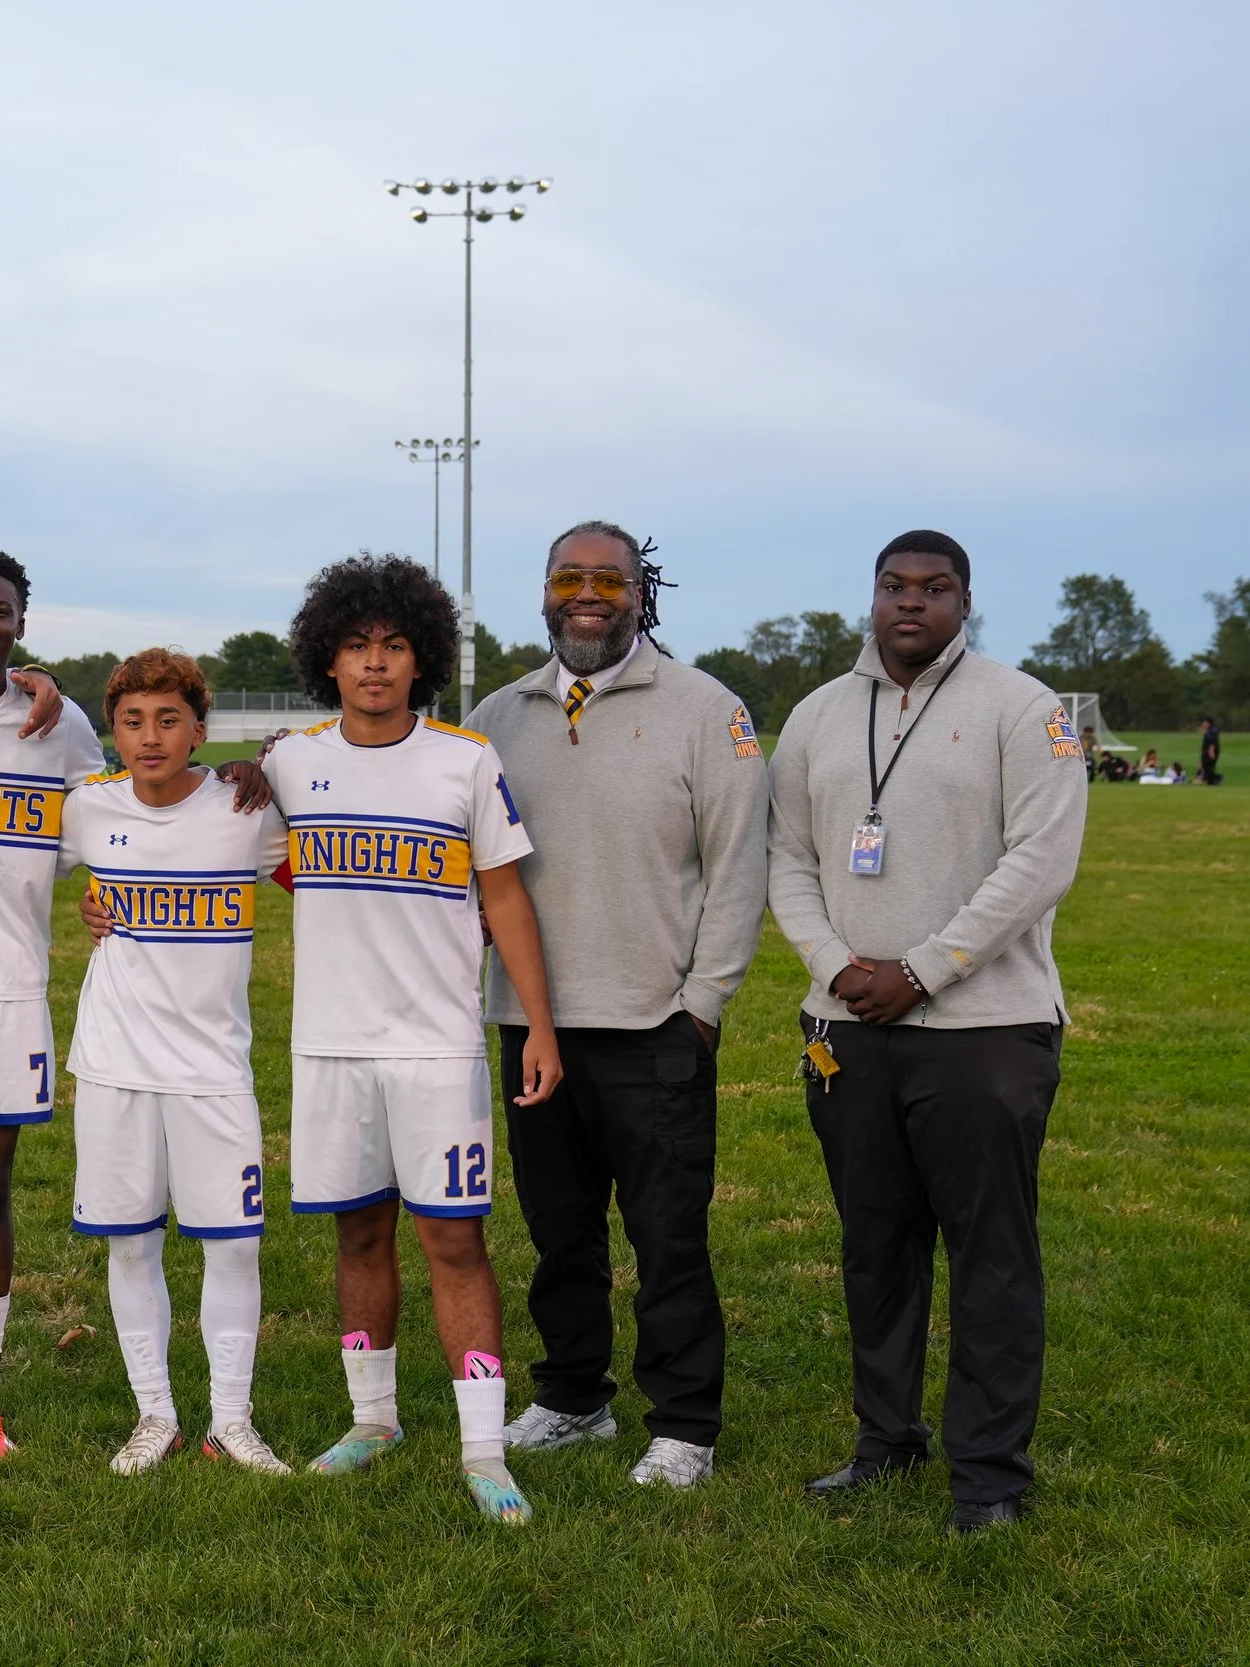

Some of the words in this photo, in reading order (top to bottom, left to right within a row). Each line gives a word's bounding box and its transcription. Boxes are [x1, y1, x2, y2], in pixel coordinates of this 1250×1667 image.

[296, 829, 448, 880] KNIGHTS
[98, 883, 243, 927] KNIGHTS
[29, 1052, 51, 1104] 7
[240, 1163, 264, 1218] 2
[444, 1143, 488, 1199] 12
